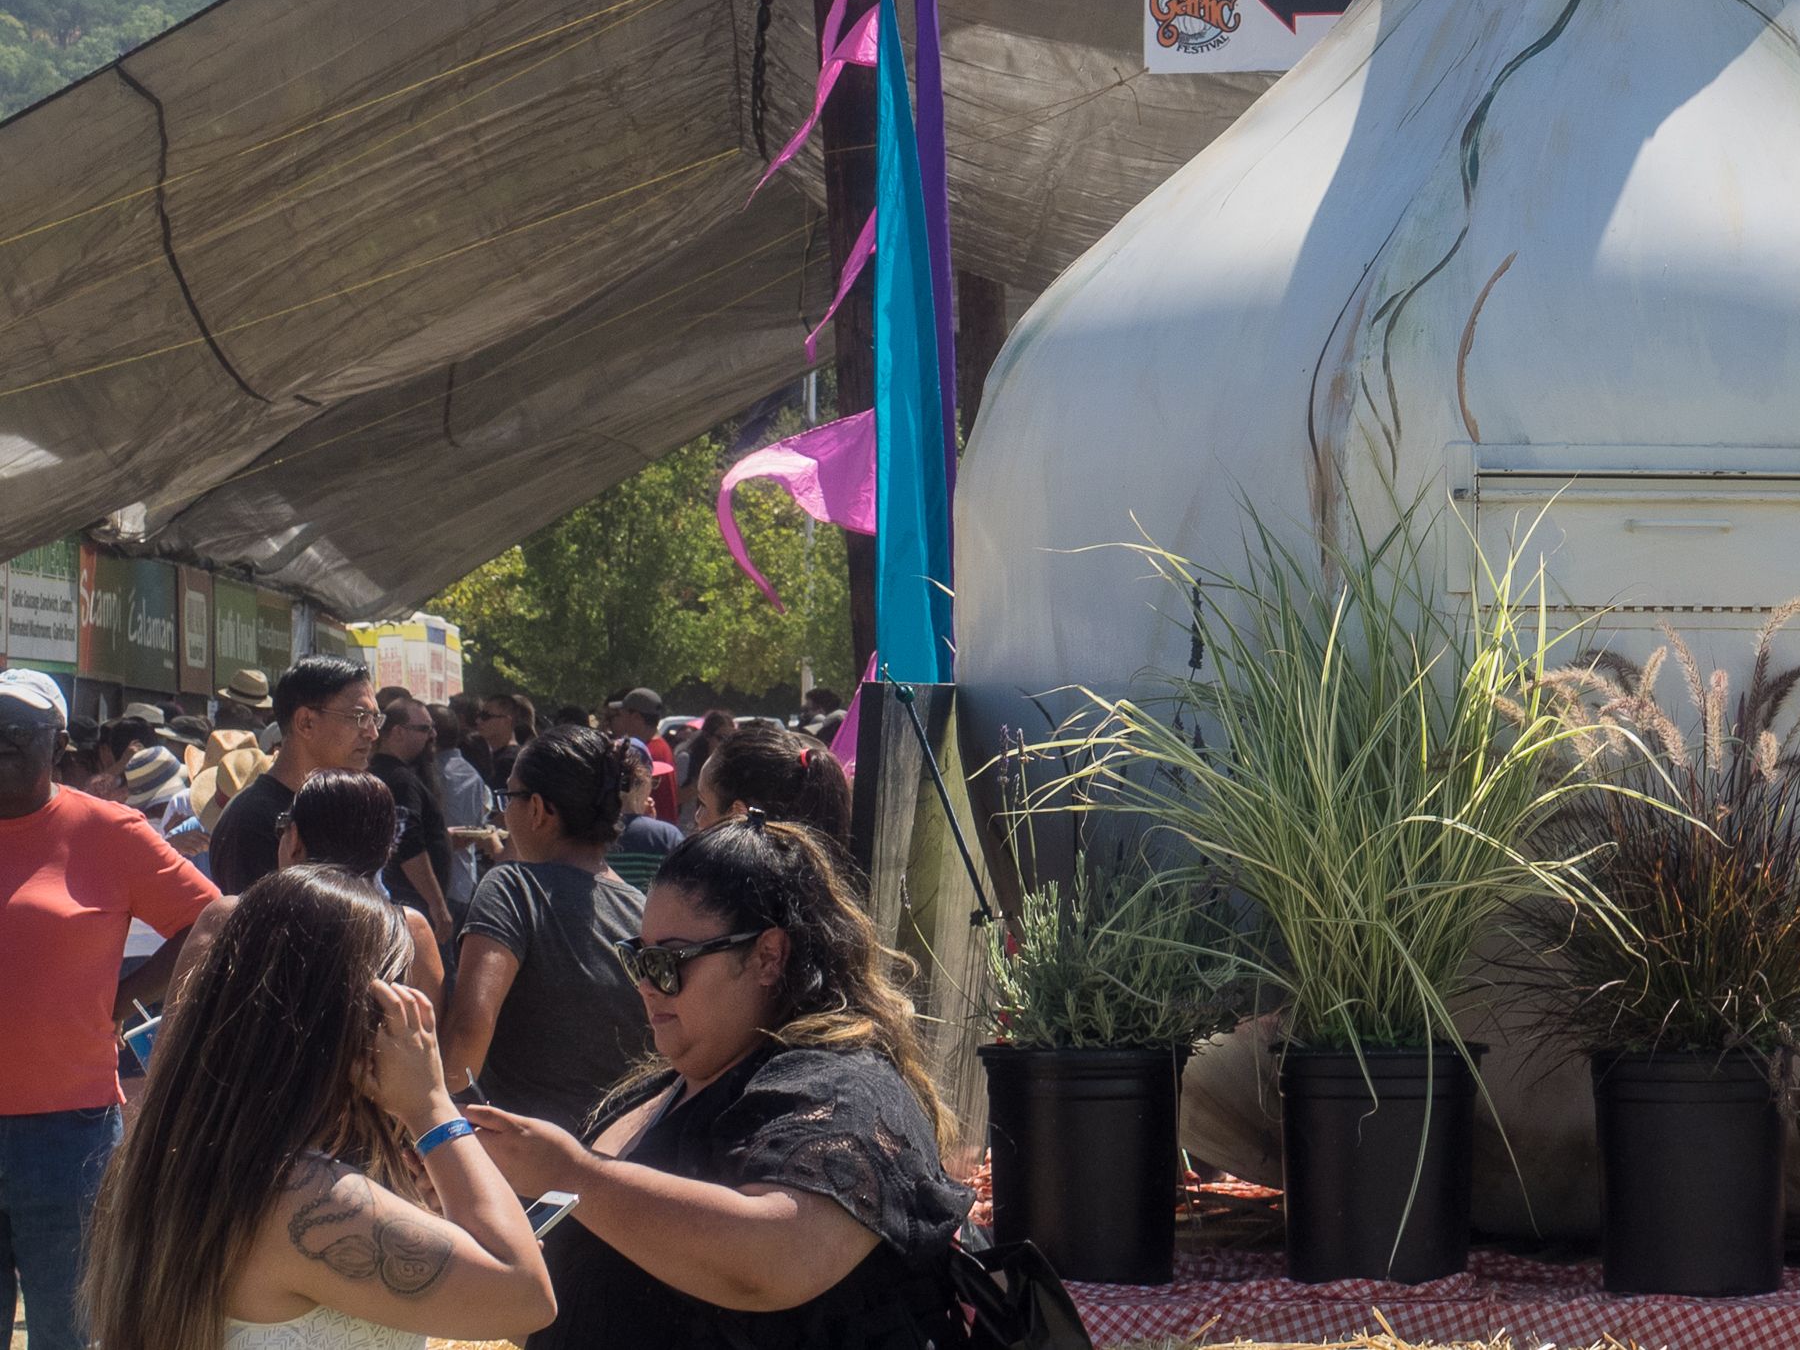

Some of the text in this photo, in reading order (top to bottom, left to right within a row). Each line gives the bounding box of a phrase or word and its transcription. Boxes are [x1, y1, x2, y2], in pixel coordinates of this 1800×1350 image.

[1176, 35, 1229, 55] FESTIVAL
[79, 568, 122, 651] Scampi
[128, 587, 175, 652] Calamari
